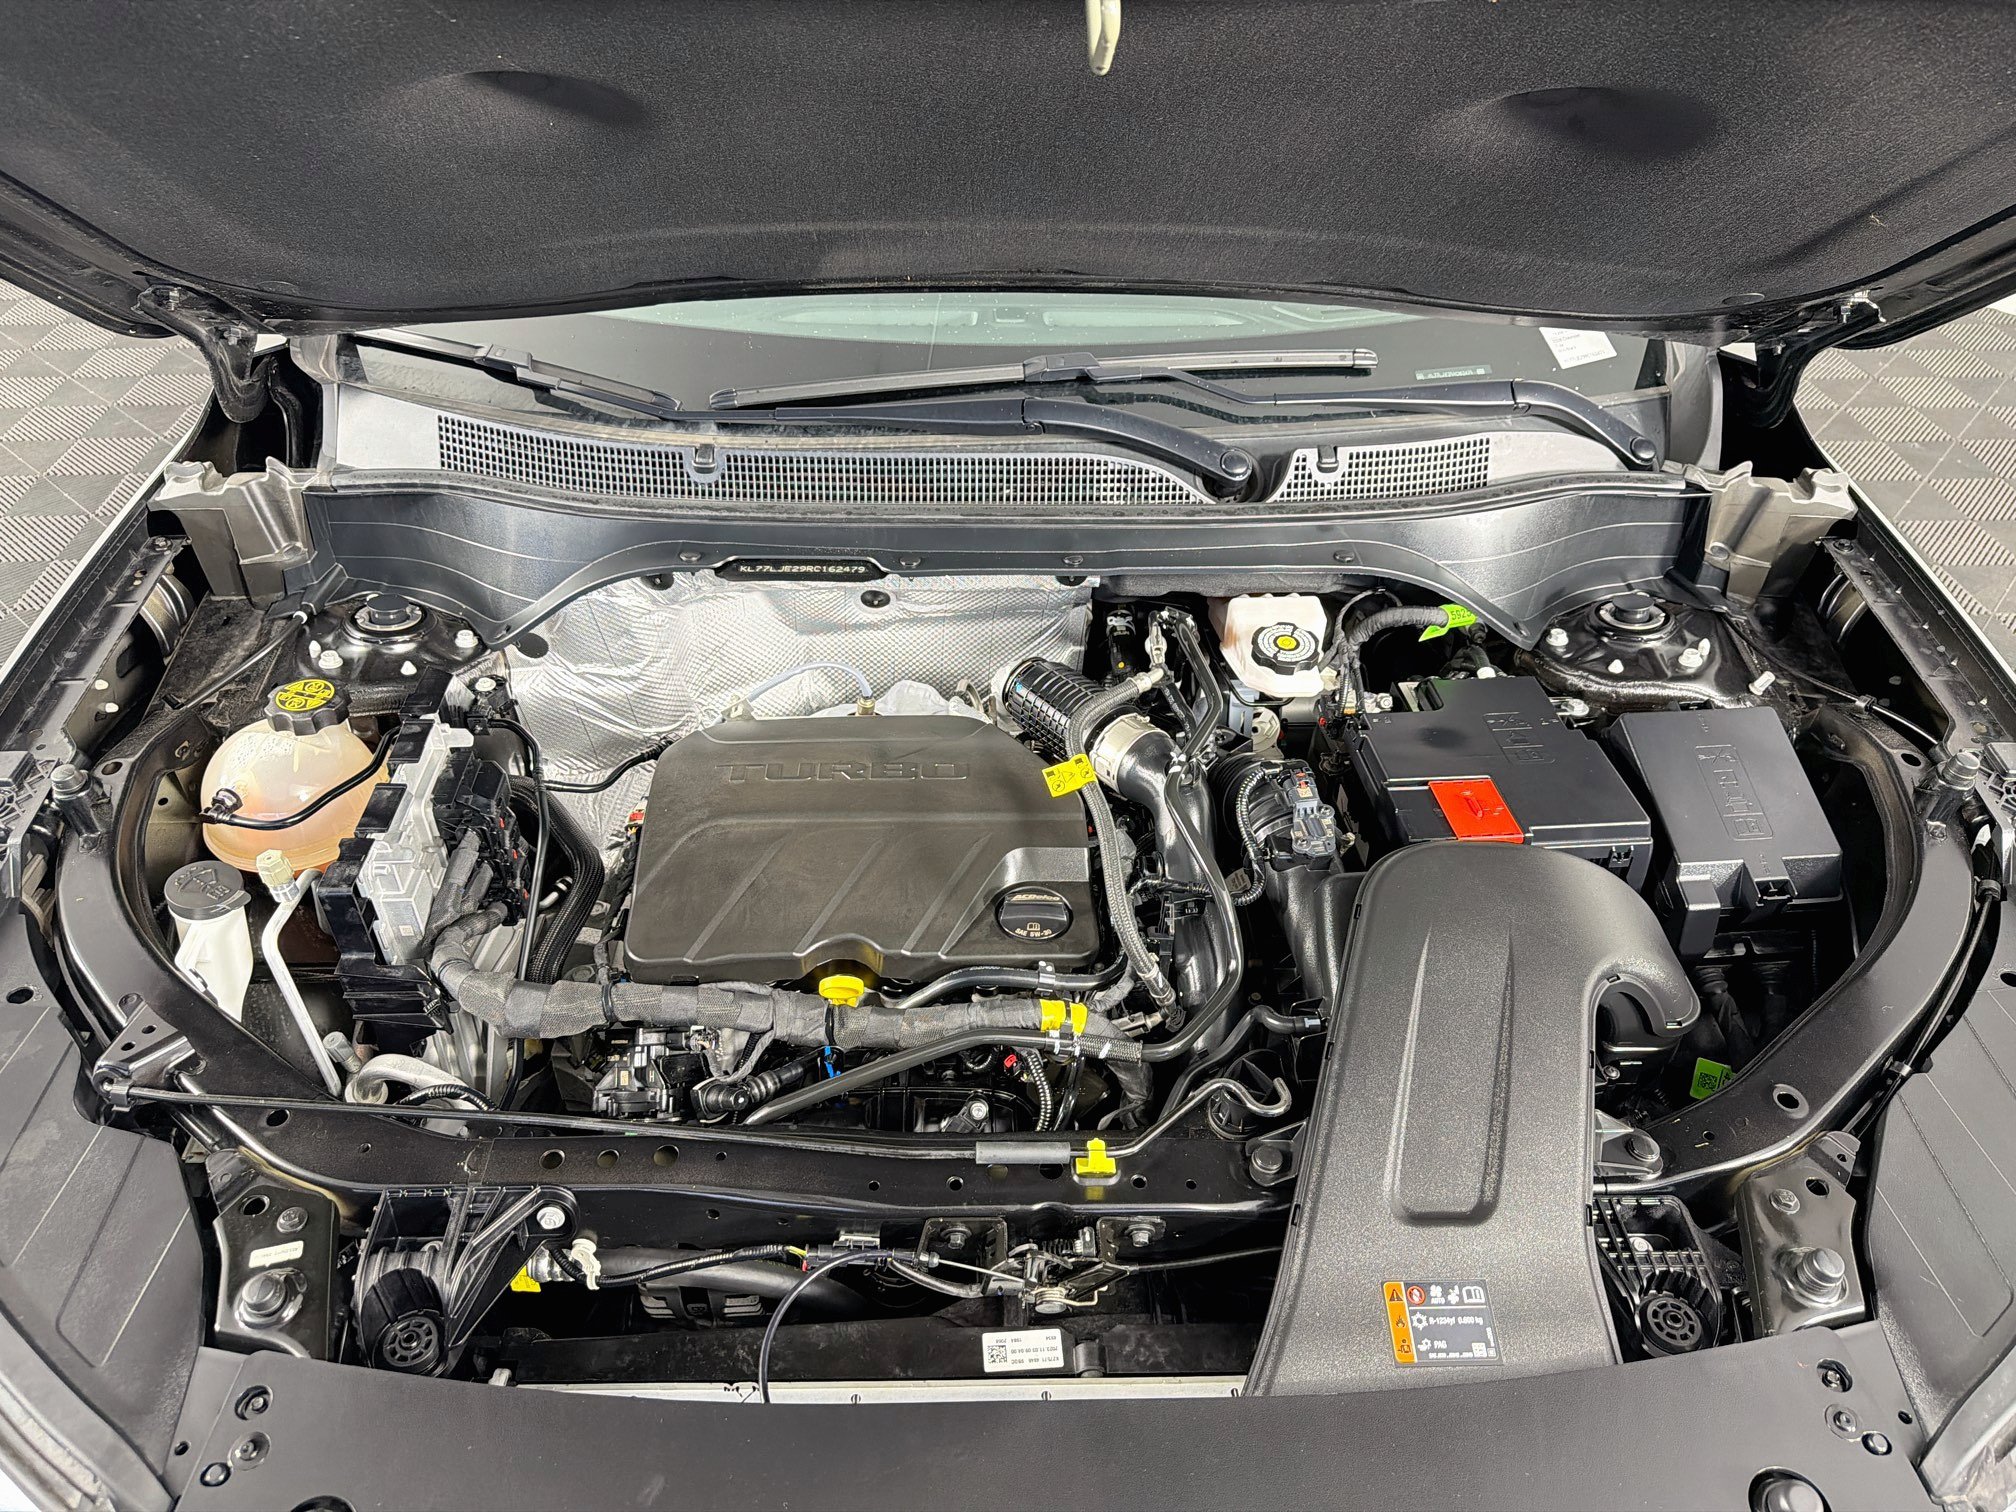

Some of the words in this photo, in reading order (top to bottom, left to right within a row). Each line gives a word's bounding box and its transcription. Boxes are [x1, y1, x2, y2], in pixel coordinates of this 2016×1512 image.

[714, 761, 970, 783] TURBO
[1011, 894, 1061, 902] ACDelco
[1015, 928, 1028, 937] SAE
